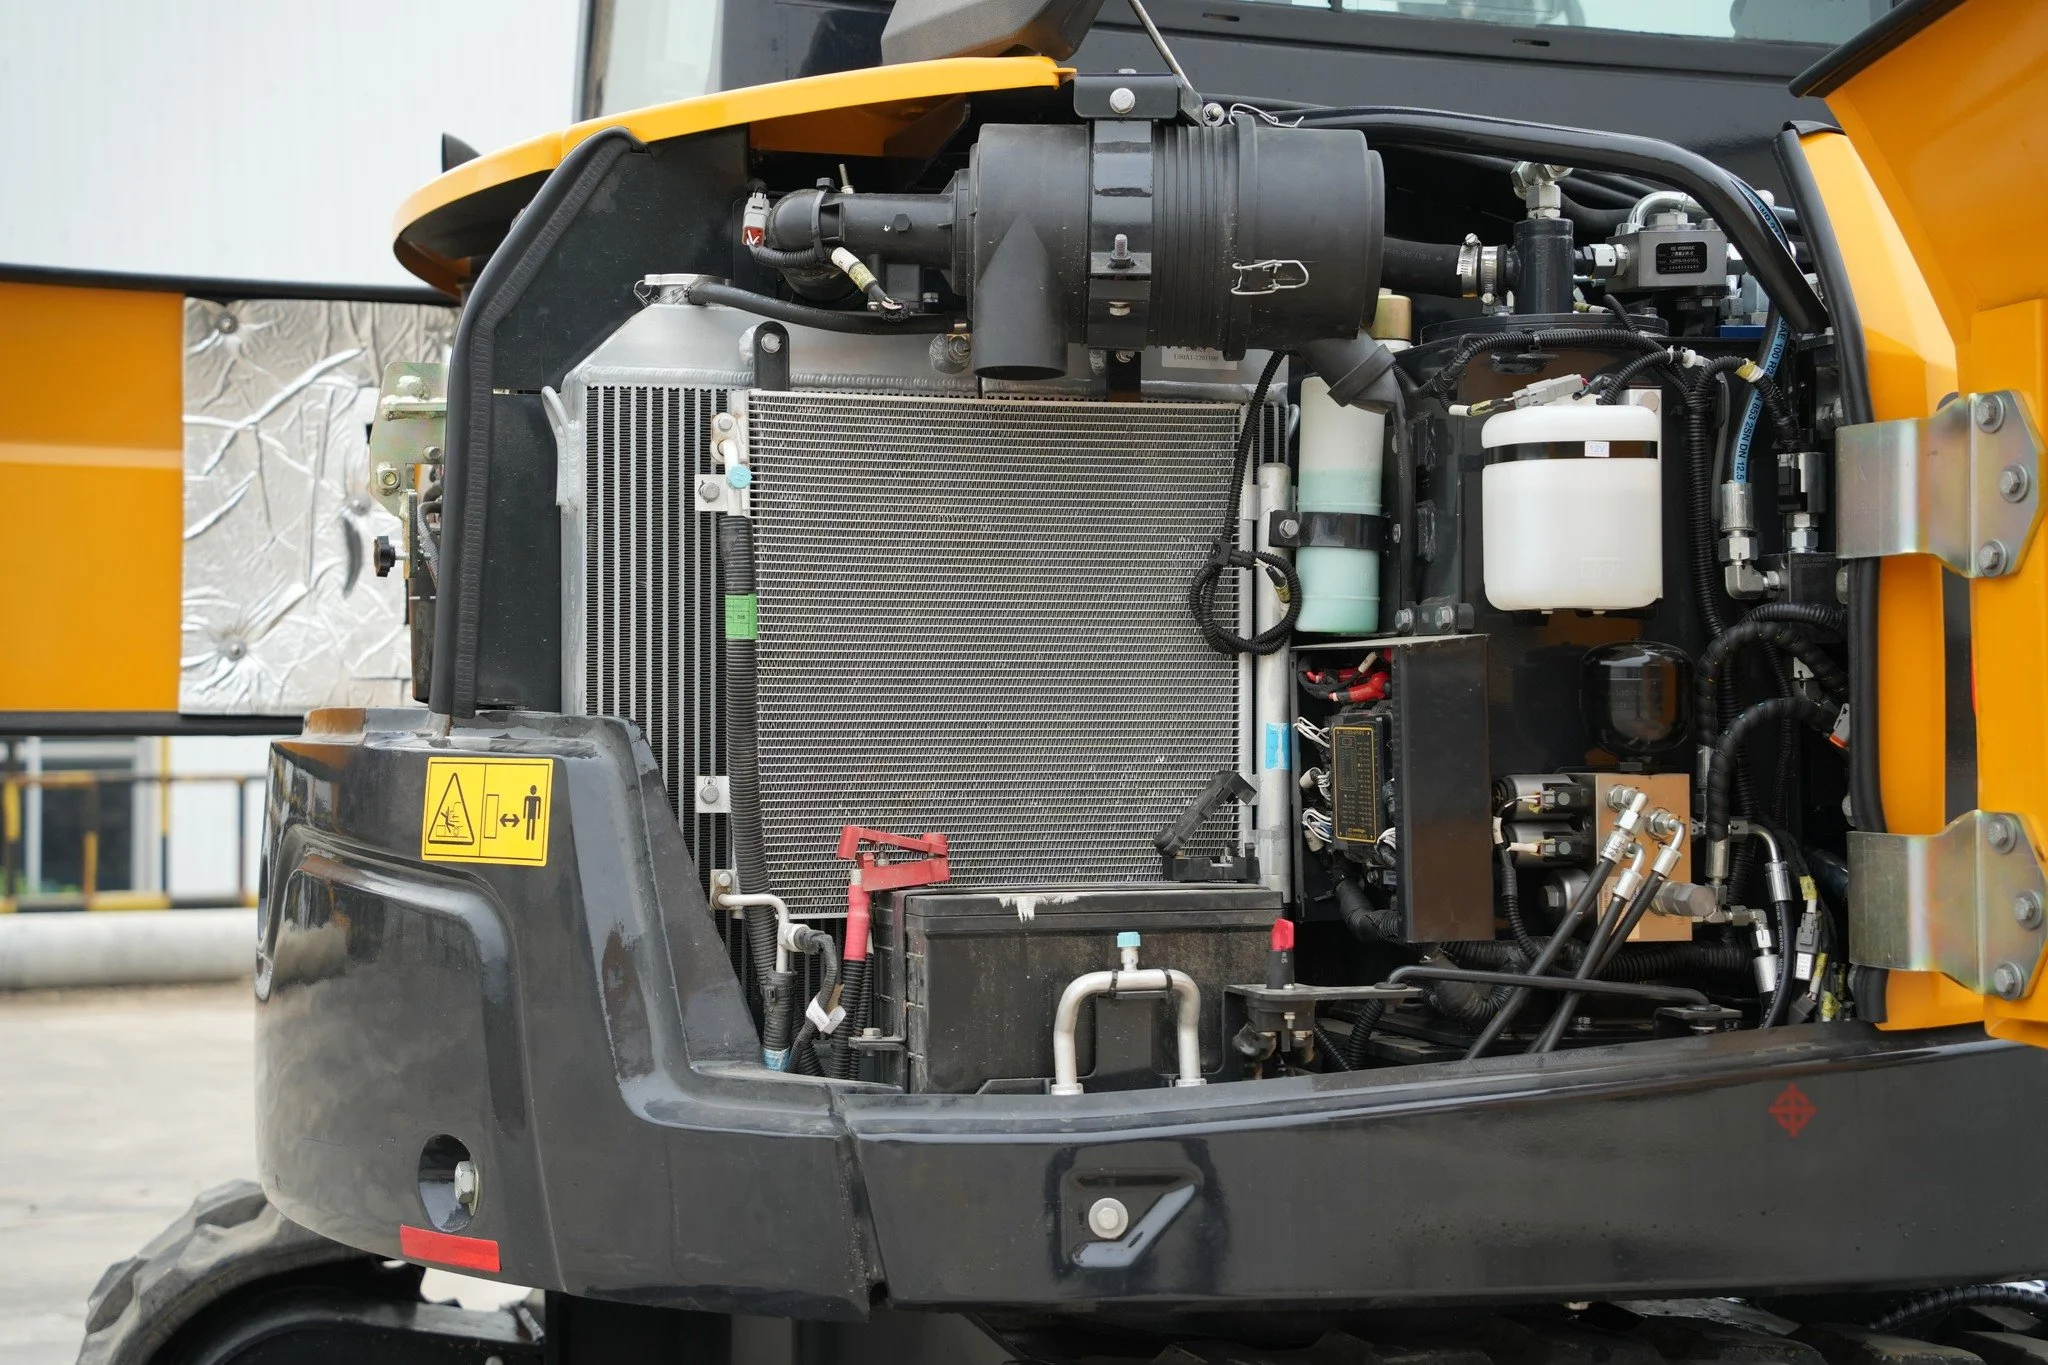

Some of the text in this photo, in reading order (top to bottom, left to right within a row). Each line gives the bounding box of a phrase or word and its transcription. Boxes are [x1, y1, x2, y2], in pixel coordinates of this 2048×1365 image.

[1772, 343, 1784, 359] 100
[1765, 361, 1778, 378] R2
[1749, 404, 1761, 421] 853
[1743, 422, 1755, 443] 2SN
[1739, 444, 1749, 459] DN
[1735, 461, 1746, 481] 12.5
